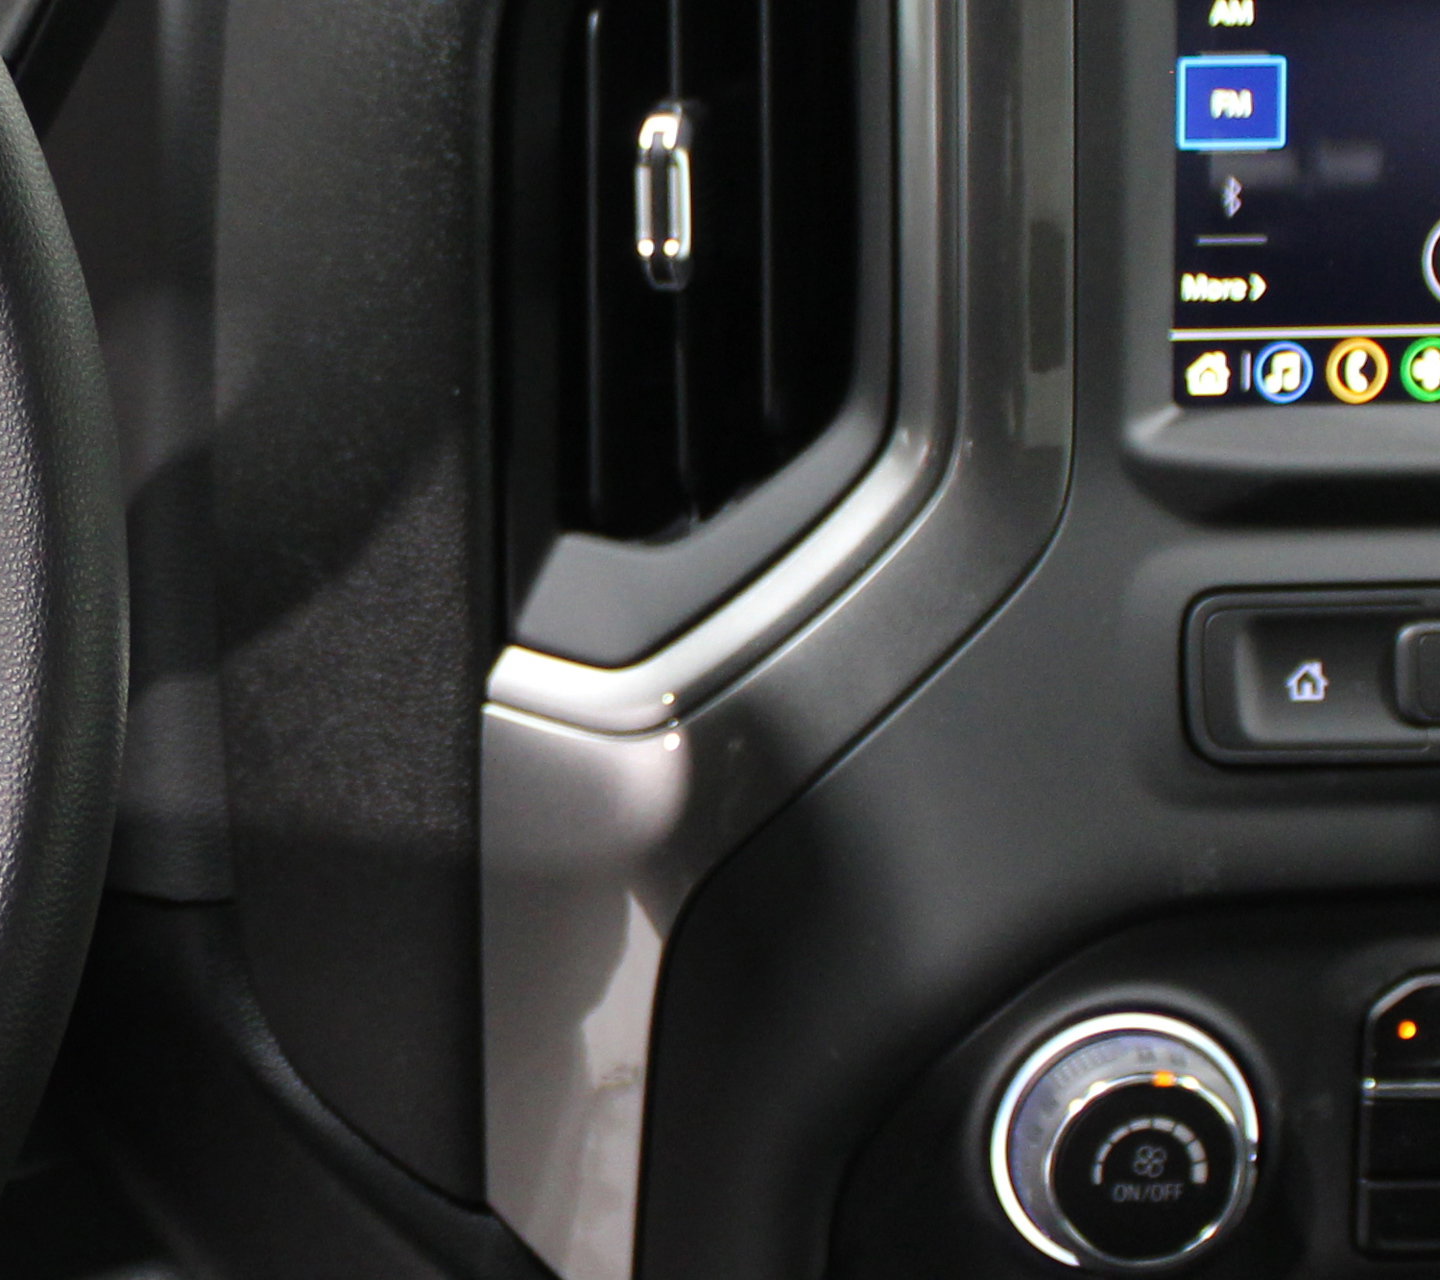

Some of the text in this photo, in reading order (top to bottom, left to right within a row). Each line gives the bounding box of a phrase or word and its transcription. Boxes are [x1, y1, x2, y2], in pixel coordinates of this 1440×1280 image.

[1210, 88, 1253, 119] FM
[1181, 272, 1248, 302] More
[1111, 1182, 1185, 1204] ON/OFF
